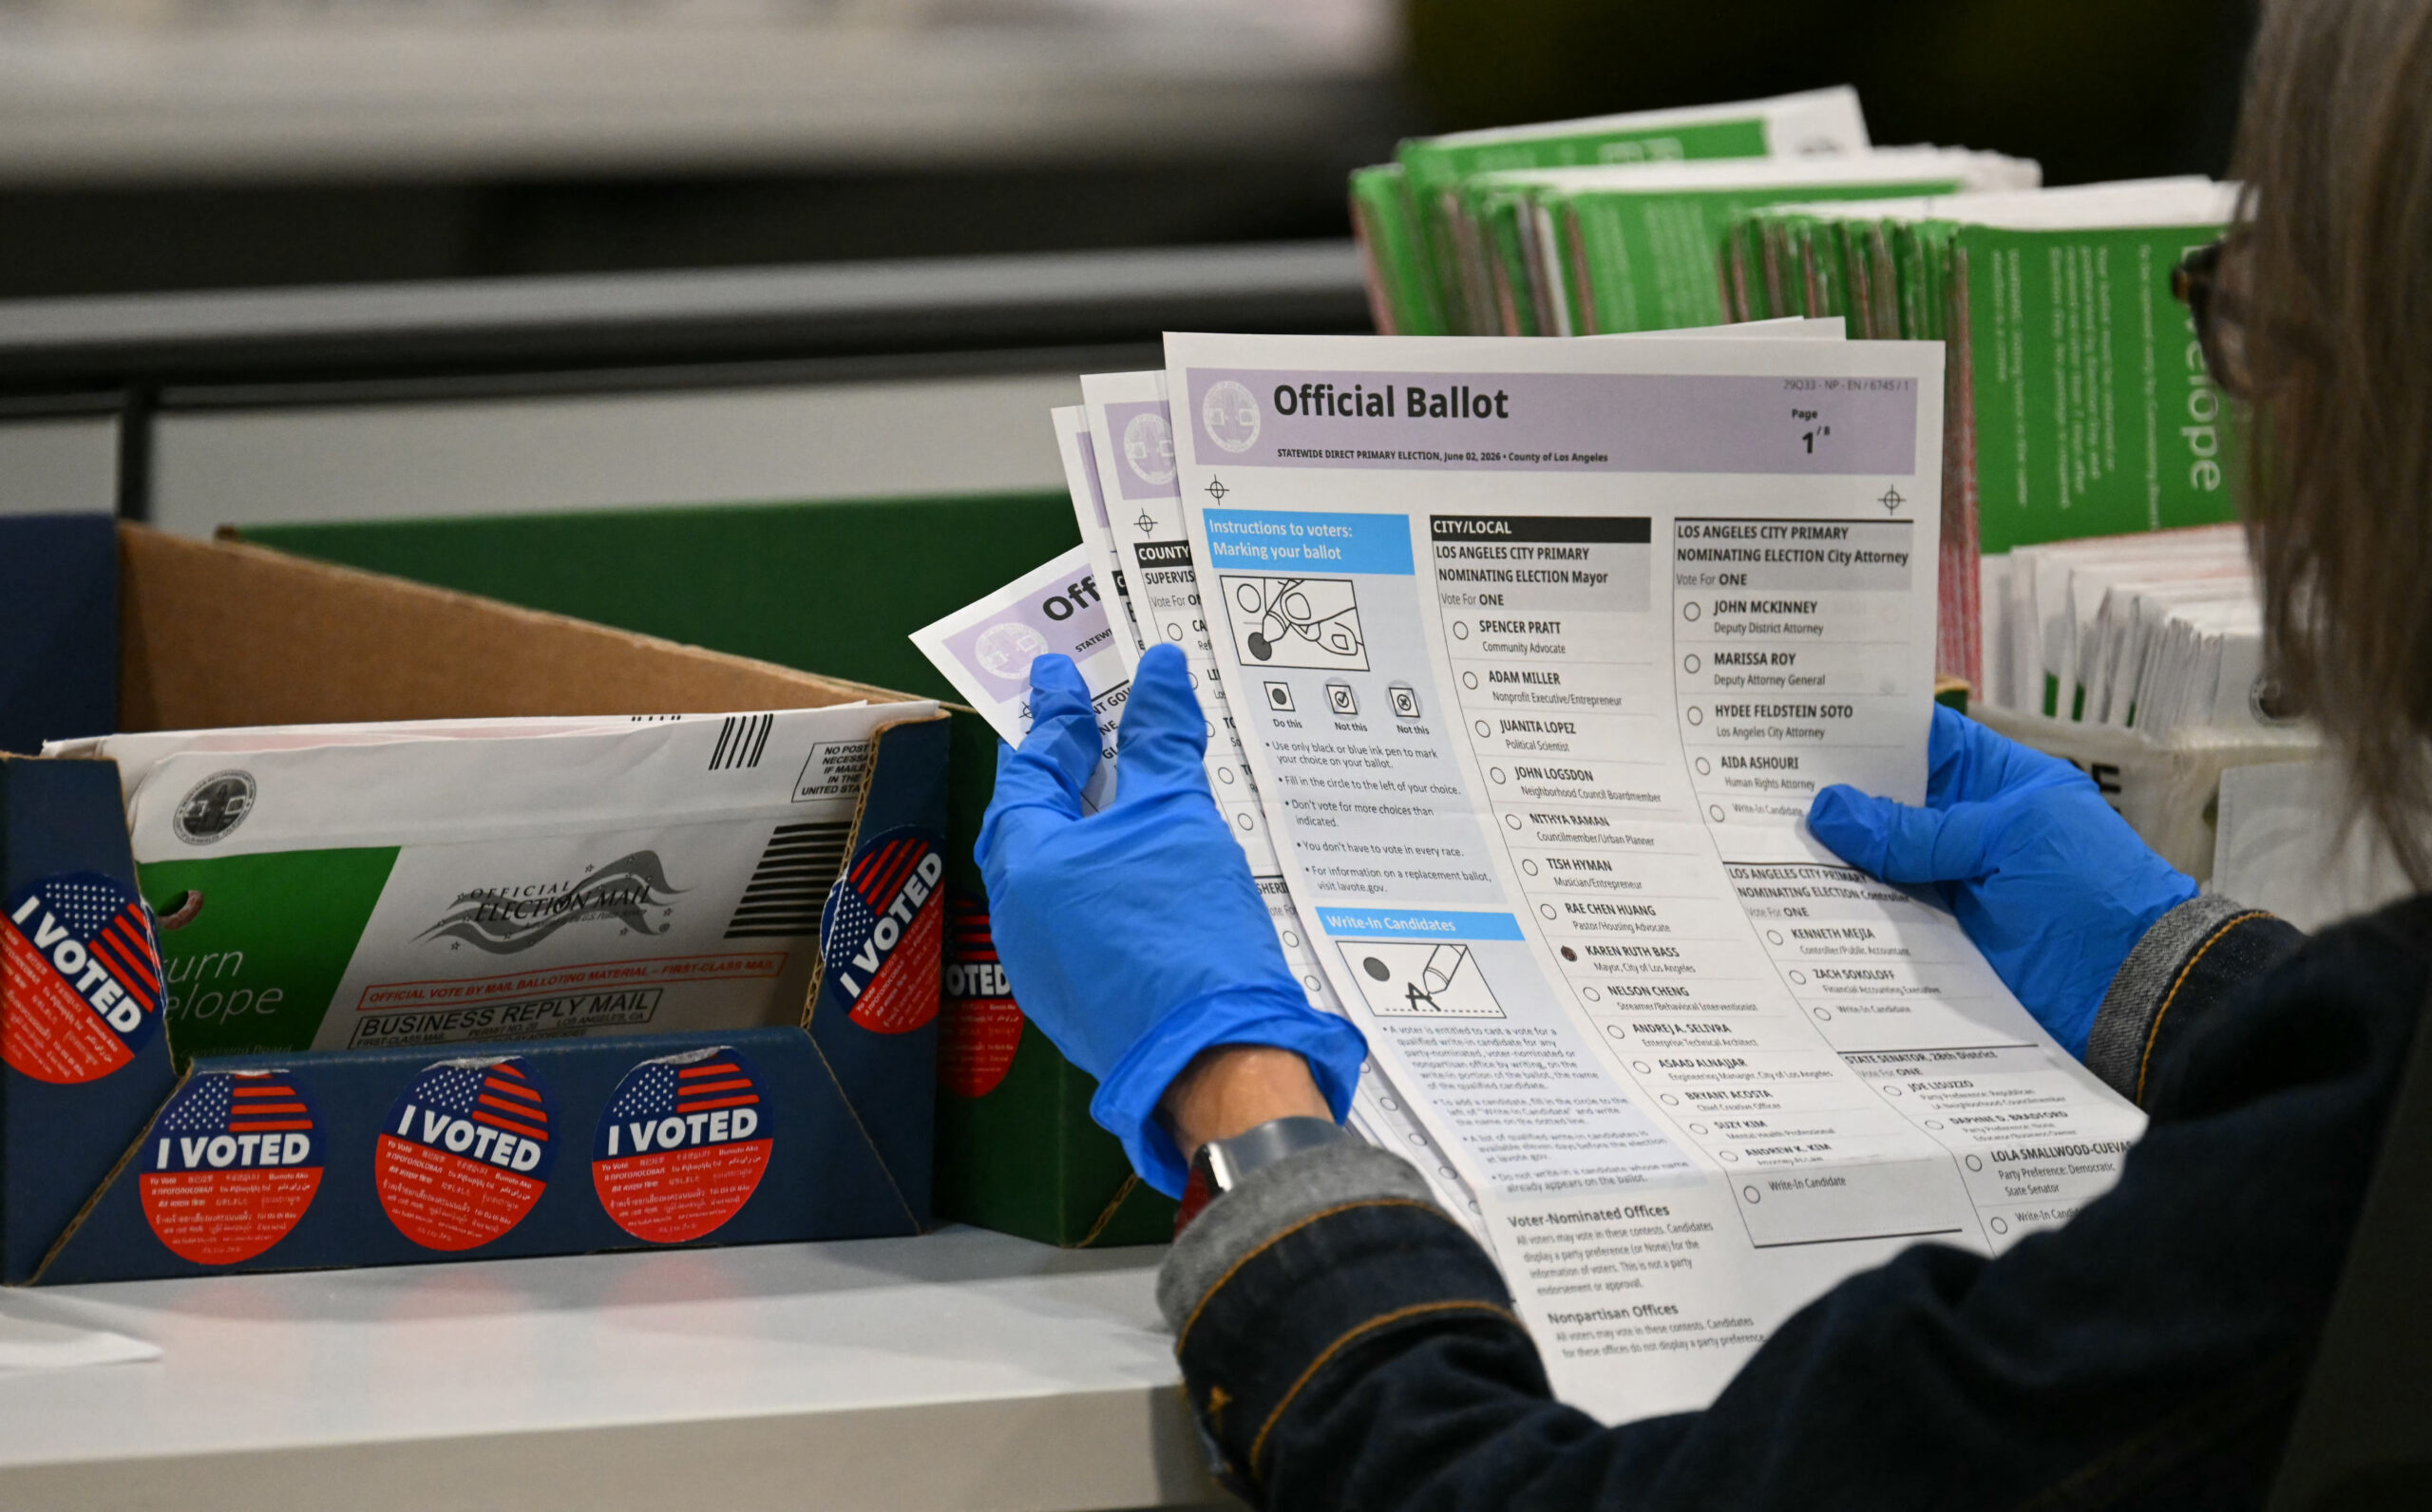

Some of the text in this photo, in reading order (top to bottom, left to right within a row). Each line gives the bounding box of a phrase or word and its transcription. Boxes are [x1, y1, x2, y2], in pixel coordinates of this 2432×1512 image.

[1274, 384, 1395, 417] Official
[1407, 386, 1510, 419] Ballot
[1792, 409, 1817, 421] Page
[1802, 432, 1814, 454] 1
[1278, 448, 1323, 459] STATEWIDE
[1325, 449, 1355, 460] DIRECT
[1357, 450, 1396, 461] PRIMARY
[1398, 451, 1442, 462] ELECTION,
[1444, 452, 1463, 463] June
[1466, 453, 1478, 463] 02,
[1481, 453, 1501, 462] 2026
[1509, 453, 1541, 463] County
[1543, 453, 1550, 462] of
[1571, 454, 1608, 464] Angeles
[1209, 520, 1353, 539] Instructions to voters:
[1434, 520, 1511, 535] CITY/LOCAL
[1678, 525, 1849, 540] LOS ANGELES CITY PRIMARY
[1138, 545, 1190, 560] COUNTY
[1214, 542, 1341, 562] Marking your ballot
[1436, 546, 1588, 560] LOS ANGELES CITY PRIMARY
[1677, 549, 1909, 567] NOMINATING ELECTION City Attorney
[1145, 570, 1195, 584] SUPERVIS
[1439, 568, 1608, 587] NOMINATING ELECTION Mayor
[1677, 574, 1747, 586] Vote For ONE
[1441, 593, 1504, 606] Vote For ONE
[1713, 600, 1818, 615] JOHN MCKINNEY
[1479, 620, 1561, 634] SPENCER PRATT
[1714, 622, 1823, 636] Deputy District Attorney
[1482, 641, 1566, 655] Community Advocate
[1715, 652, 1796, 666] MARISSA ROY
[1489, 671, 1560, 685] ADAM MILLER
[1714, 674, 1825, 688] Deputy Attorney General
[1492, 691, 1622, 708] Nonprofit Executive/Entrepreneur
[1716, 705, 1853, 718] HYDEE FELDSTEIN SOTO
[1335, 723, 1368, 732] Not this
[1500, 720, 1576, 735] JUANITA LOPEZ
[1717, 727, 1825, 740] Los Angeles City Attorney
[825, 745, 870, 755] NO POST
[1273, 742, 1289, 751] Use
[1291, 743, 1310, 753] only
[1312, 744, 1335, 754] black
[1347, 745, 1368, 755] blue
[1370, 747, 1382, 756] ink
[1385, 748, 1402, 759] pen
[1404, 748, 1414, 757] to
[1416, 748, 1437, 758] mark
[1506, 739, 1569, 752] Political Scientist
[835, 764, 866, 773] MAILE
[1721, 756, 1799, 769] AIDA ASHOURI
[1515, 766, 1593, 782] JOHN LOGSDON
[802, 784, 861, 795] UNITED STA
[1530, 813, 1609, 828] NITHYA RAMAN
[1546, 858, 1612, 872] TISH HYMAN
[471, 881, 570, 898] OFFICIAL
[475, 884, 651, 922] ELECTION MAIL
[1565, 902, 1656, 917] RAE CHEN HUANG
[840, 972, 861, 998] I
[852, 852, 942, 974] VOTED
[1326, 917, 1455, 936] Write-In Candidates
[1791, 928, 1874, 941] KENNETH MEJIA
[1585, 945, 1680, 958] KAREN RUTH BASS
[11, 896, 40, 925] I
[34, 911, 142, 1032] VOTED
[163, 951, 243, 983] urn
[370, 989, 425, 1002] OFFICIAL
[430, 986, 463, 998] VOTE
[465, 984, 484, 996] BY
[485, 981, 513, 993] MAIL
[516, 973, 585, 990] BALLOTING
[588, 966, 648, 980] MATERIAL
[748, 960, 773, 971] MAIL
[948, 964, 1012, 997] OTED
[1813, 969, 1894, 980] ZACH SOKOLOFF
[1607, 986, 1689, 997] NELSON CHENG
[166, 983, 283, 1026] elope
[361, 1009, 496, 1036] BUSINESS
[502, 997, 587, 1023] REPLY
[590, 991, 650, 1012] MAIL
[397, 1105, 541, 1171] I VOTED
[608, 1108, 758, 1156] I VOTED
[157, 1134, 310, 1169] I VOTED
[1990, 1150, 2021, 1162] LOLA
[1769, 1176, 1847, 1193] Write-In Candidate
[1507, 1204, 1670, 1228] Voter-Nominated Offices
[1548, 1303, 1679, 1326] Nonpartisan Offices
